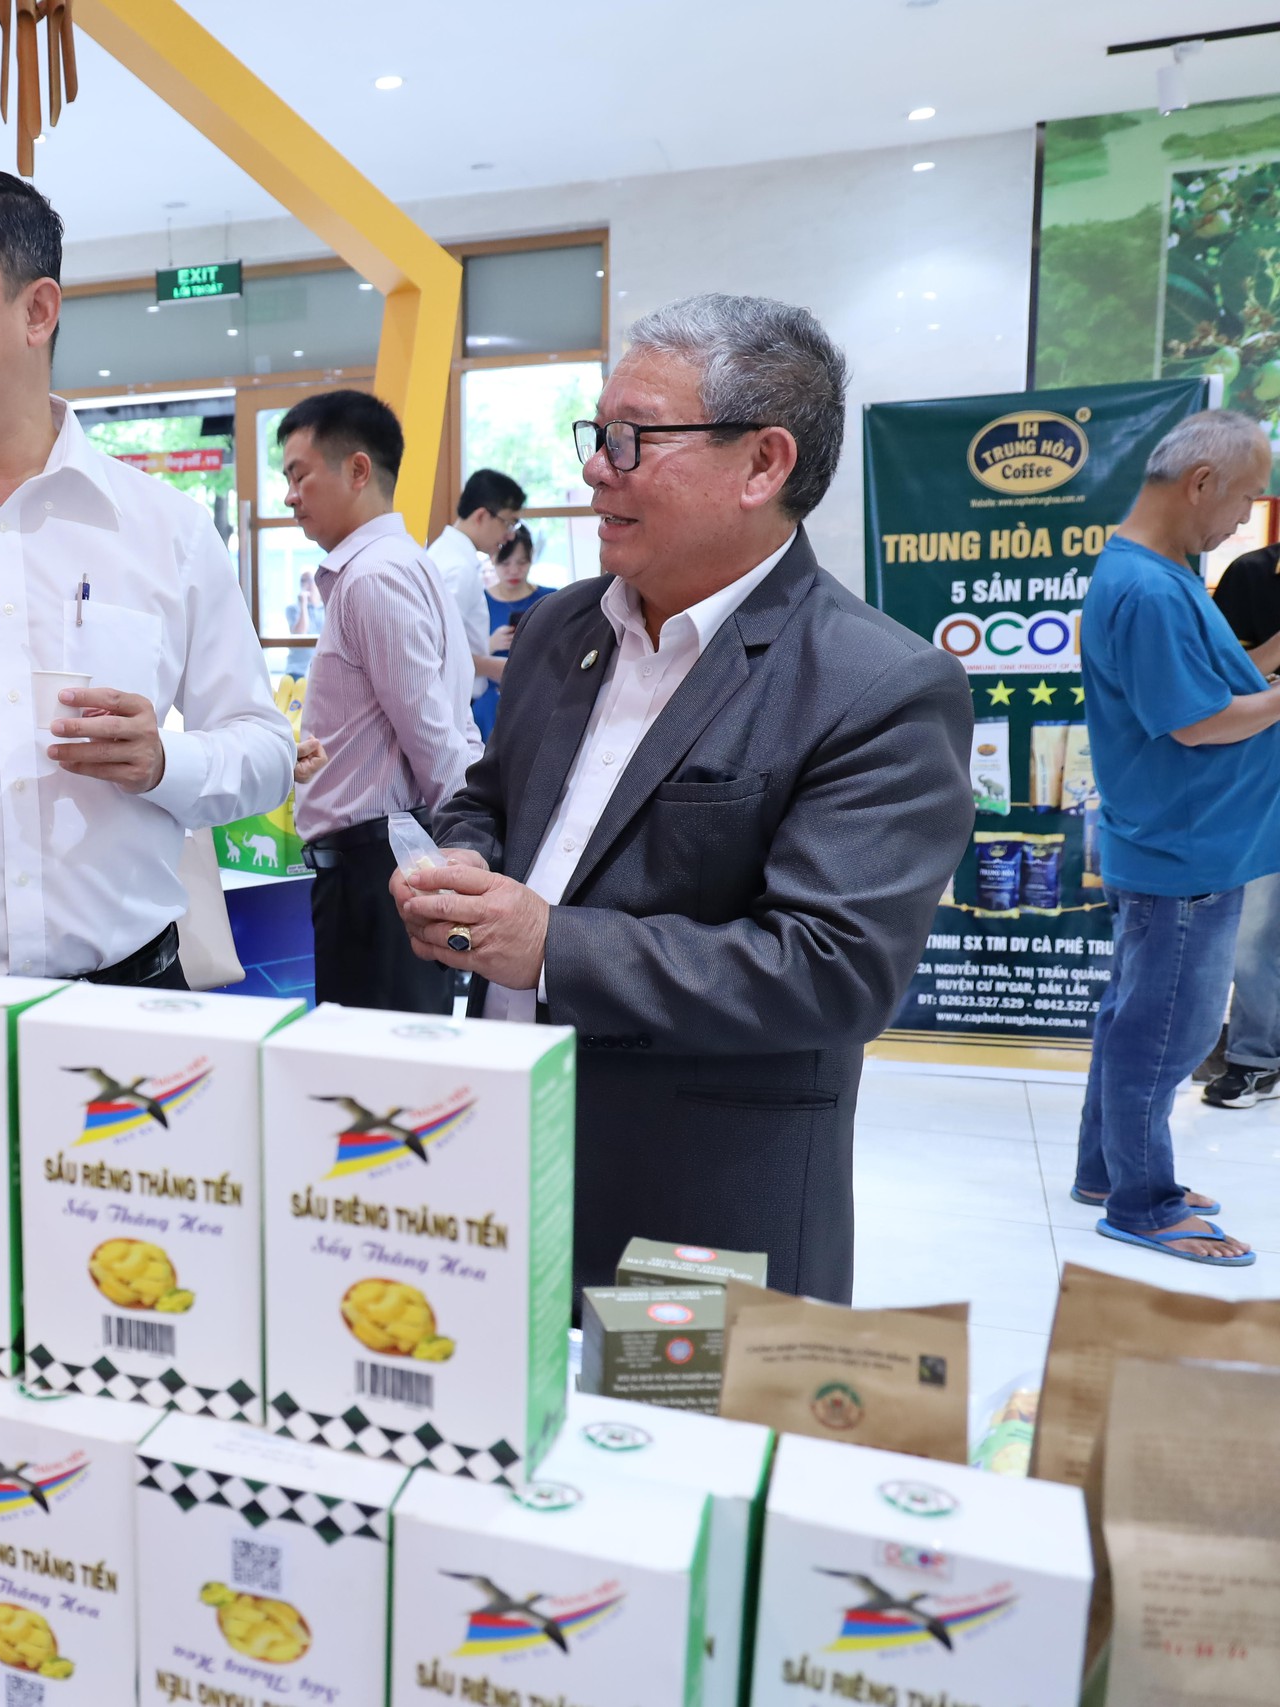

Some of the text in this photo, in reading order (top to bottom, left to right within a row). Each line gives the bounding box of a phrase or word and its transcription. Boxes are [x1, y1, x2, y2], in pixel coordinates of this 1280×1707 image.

[177, 265, 219, 285] EXIT
[981, 437, 1075, 466] TRUNG HÒA
[1001, 463, 1053, 480] Coffee
[882, 531, 981, 563] TRUNG
[989, 521, 1053, 560] HÒA
[951, 580, 966, 604] 5
[972, 572, 1021, 603] SẢN
[963, 935, 983, 951] SX
[986, 936, 1008, 951] TM
[1010, 937, 1030, 952] DV
[1032, 934, 1052, 953] CÀ
[1055, 936, 1084, 954] PHÊ
[934, 960, 979, 976] NGUYỄN
[936, 977, 974, 994] HUYỆN
[81, 1161, 132, 1194] RIÊNG
[202, 1170, 244, 1206] TIẾN
[62, 1198, 98, 1224] Sấy
[178, 1213, 225, 1237] Hoa
[332, 1196, 389, 1230] RIÊNG
[465, 1211, 509, 1251] TIẾN
[312, 1236, 352, 1262] Sấy
[437, 1254, 487, 1283] Hoa
[80, 1560, 119, 1594] TIẾN
[58, 1592, 101, 1620] Hoa
